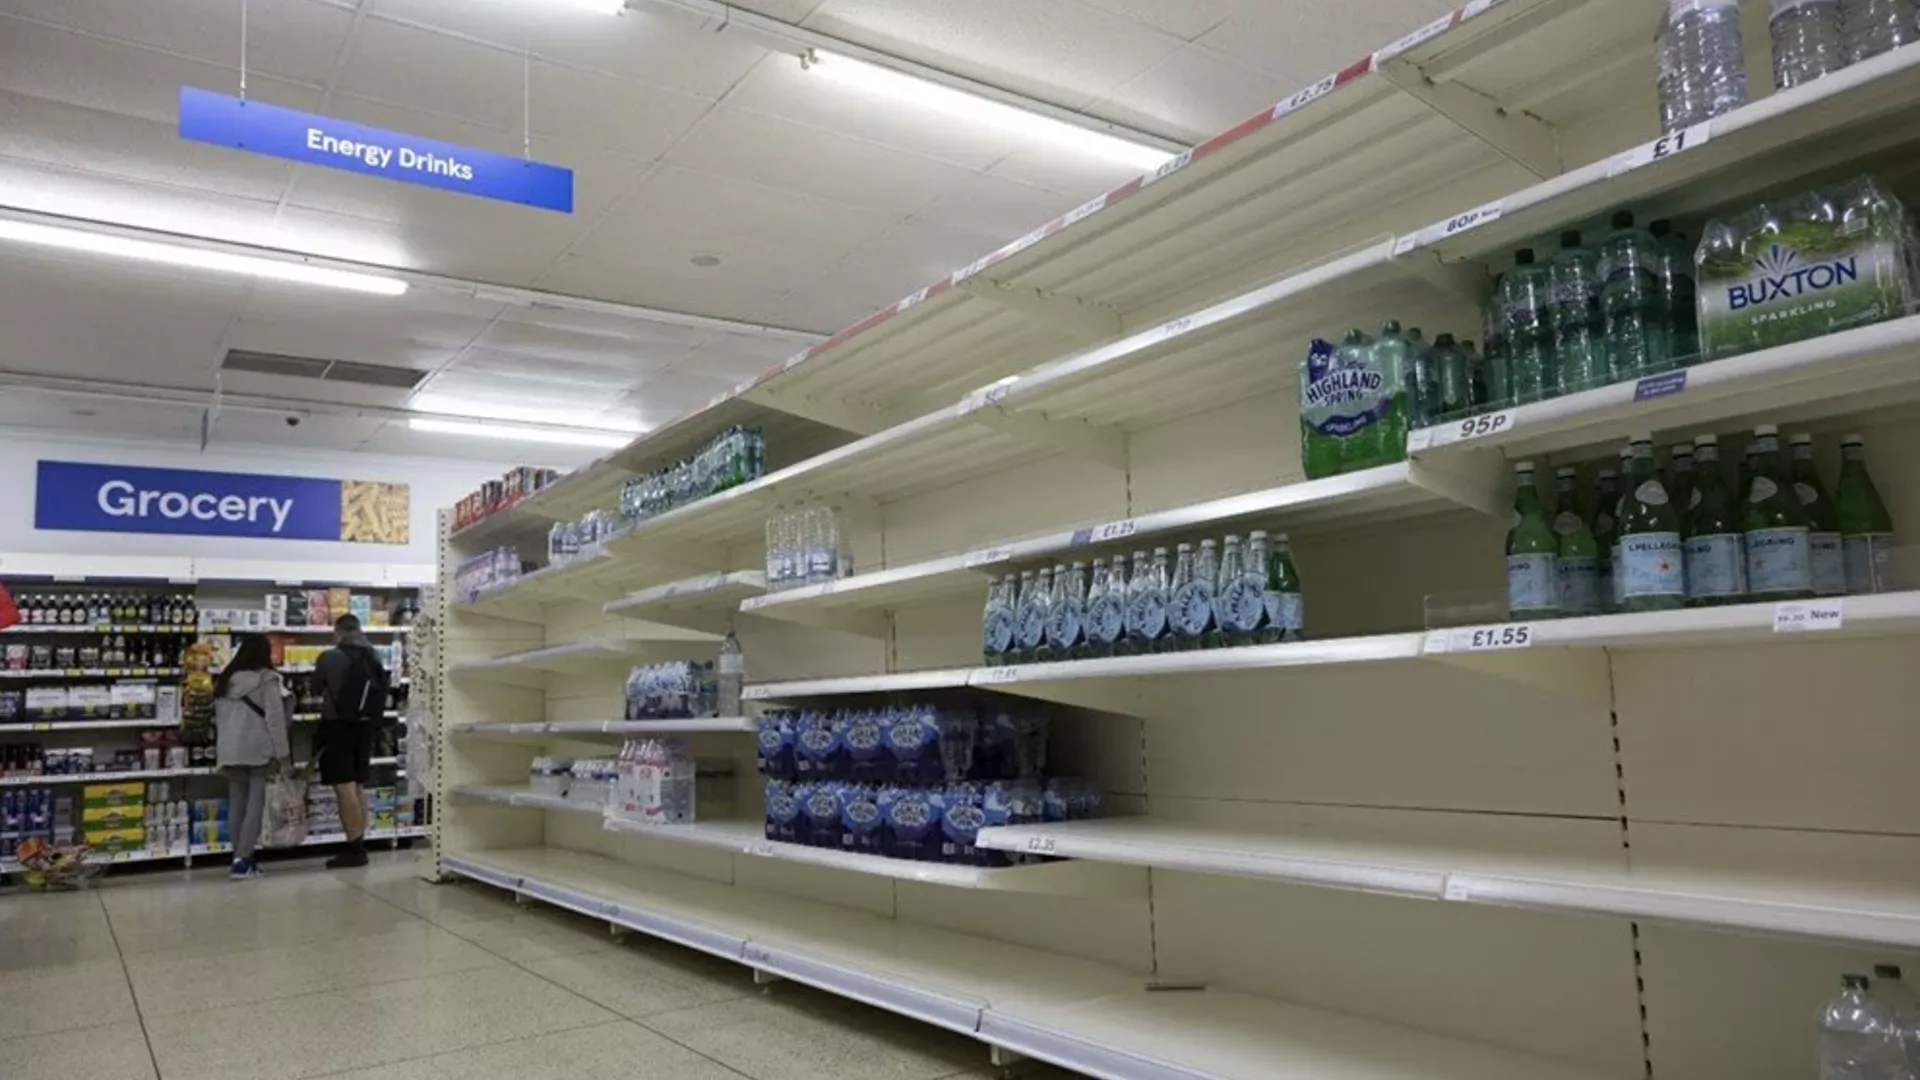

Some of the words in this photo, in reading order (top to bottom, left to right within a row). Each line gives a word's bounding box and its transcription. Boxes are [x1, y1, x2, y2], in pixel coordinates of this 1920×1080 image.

[307, 128, 392, 168] Energy
[399, 147, 474, 181] Drinks
[1652, 131, 1686, 159] £1
[1728, 255, 1858, 310] BUXTON
[1751, 299, 1837, 325] SPARKLING
[1306, 370, 1381, 405] HIGHLAND
[1324, 389, 1364, 407] SPRING
[98, 479, 294, 532] Grocery
[1811, 609, 1840, 620] New
[1472, 626, 1529, 648] £1.55
